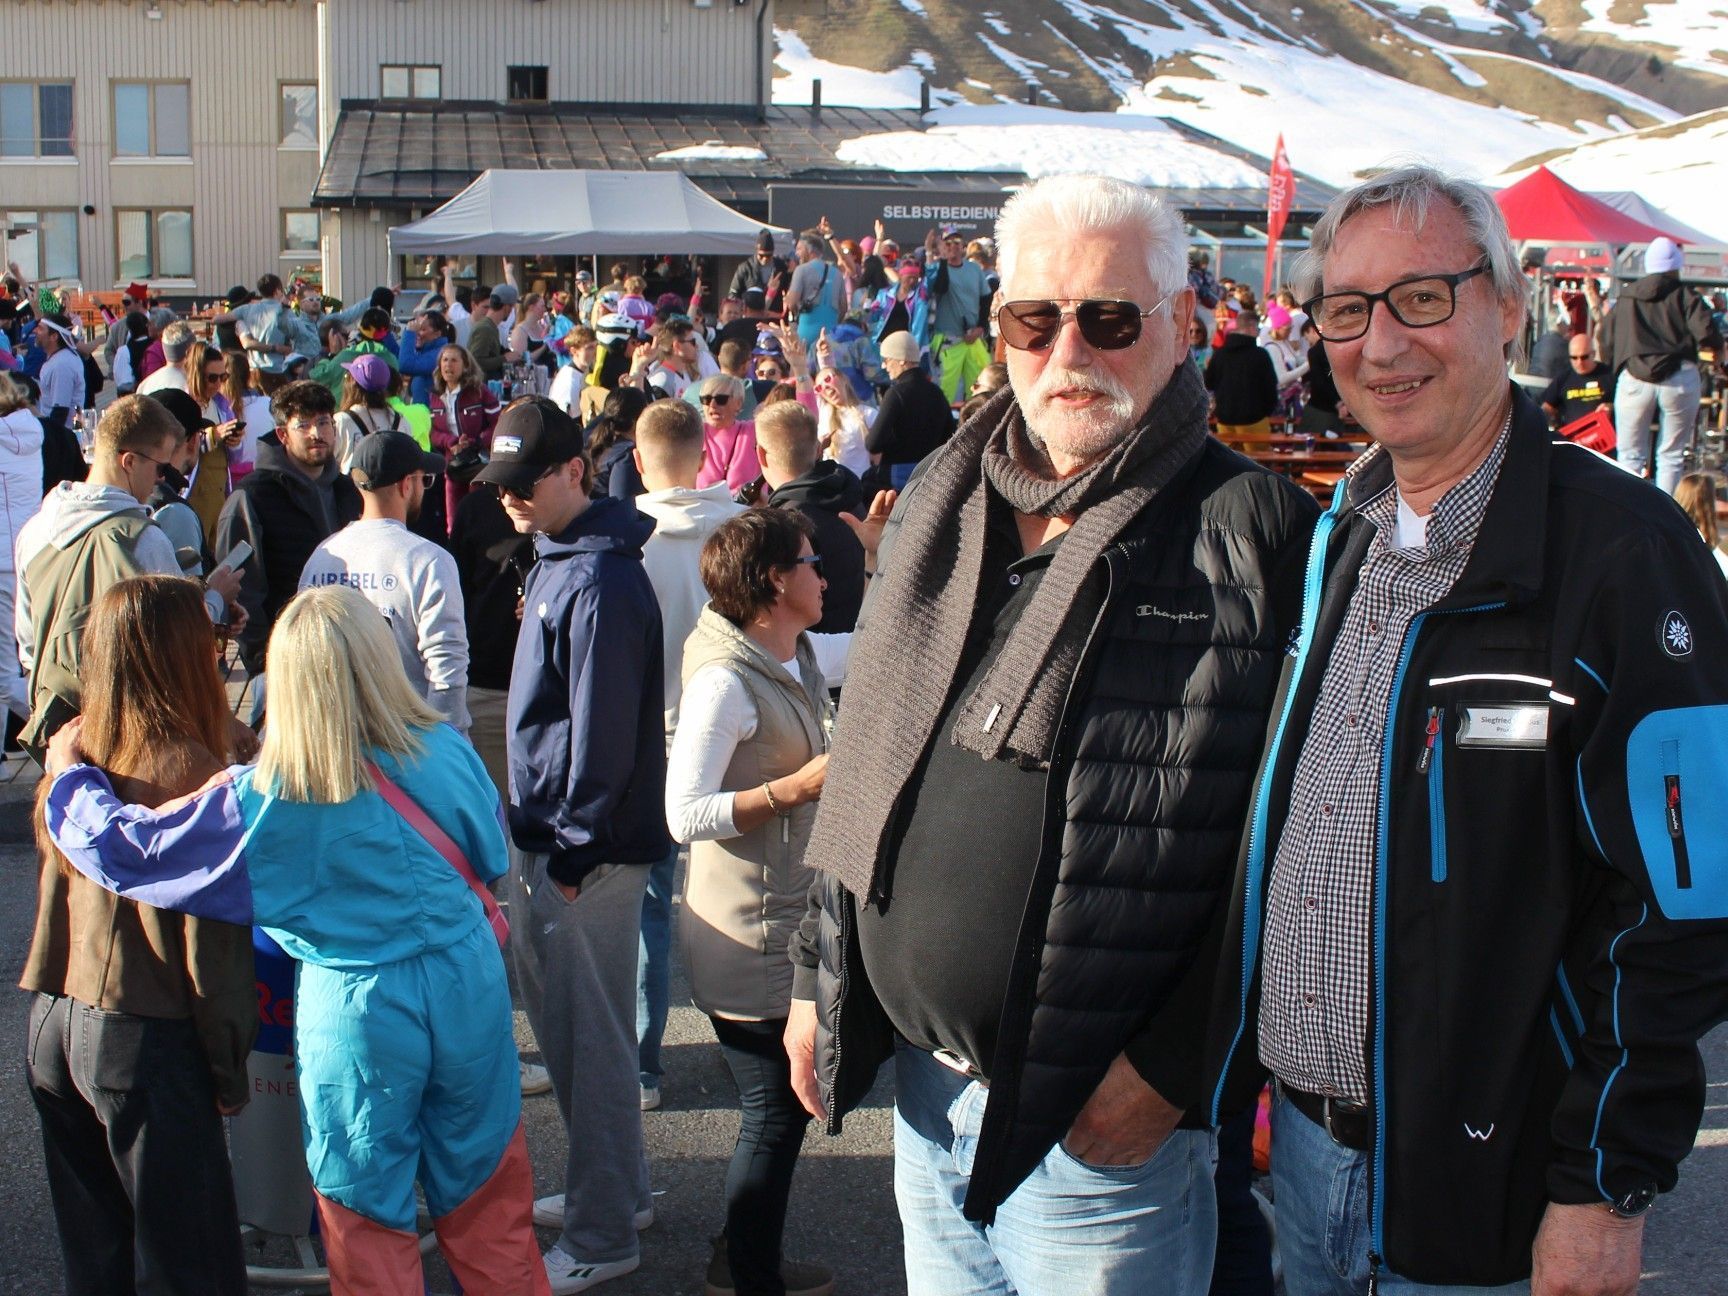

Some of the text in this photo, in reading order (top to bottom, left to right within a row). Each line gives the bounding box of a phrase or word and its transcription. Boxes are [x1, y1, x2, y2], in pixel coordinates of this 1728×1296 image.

[1136, 604, 1209, 624] Champion
[1480, 716, 1512, 725] Siegfried
[256, 980, 295, 1028] Re
[255, 1077, 296, 1097] ENE
